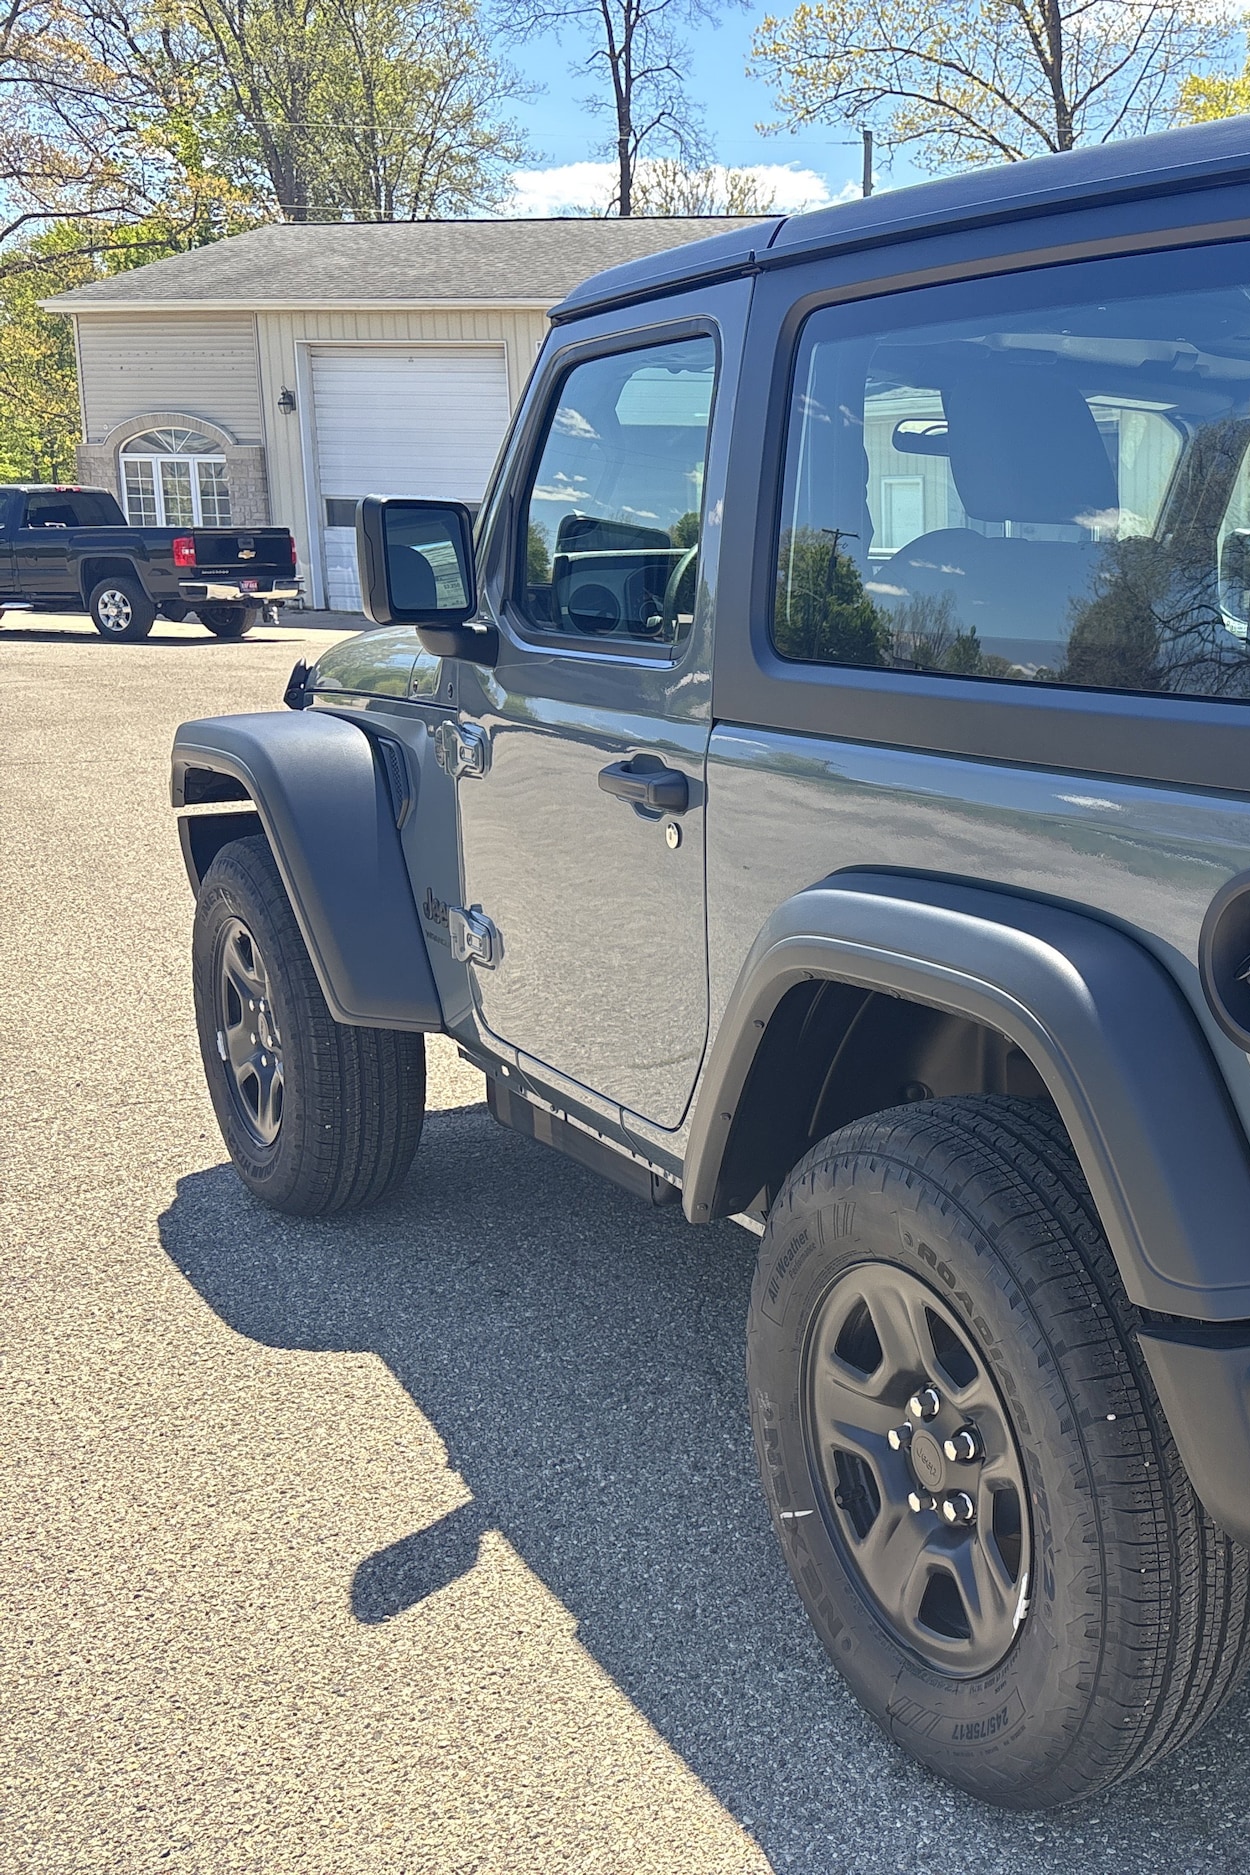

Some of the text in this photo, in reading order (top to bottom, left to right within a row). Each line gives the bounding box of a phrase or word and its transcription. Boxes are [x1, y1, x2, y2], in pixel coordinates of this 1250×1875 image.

[422, 886, 449, 929] Jee
[767, 1228, 810, 1305] All-Weather
[917, 1241, 1032, 1436] ROADIAN
[951, 1706, 1009, 1741] 245/75R17
